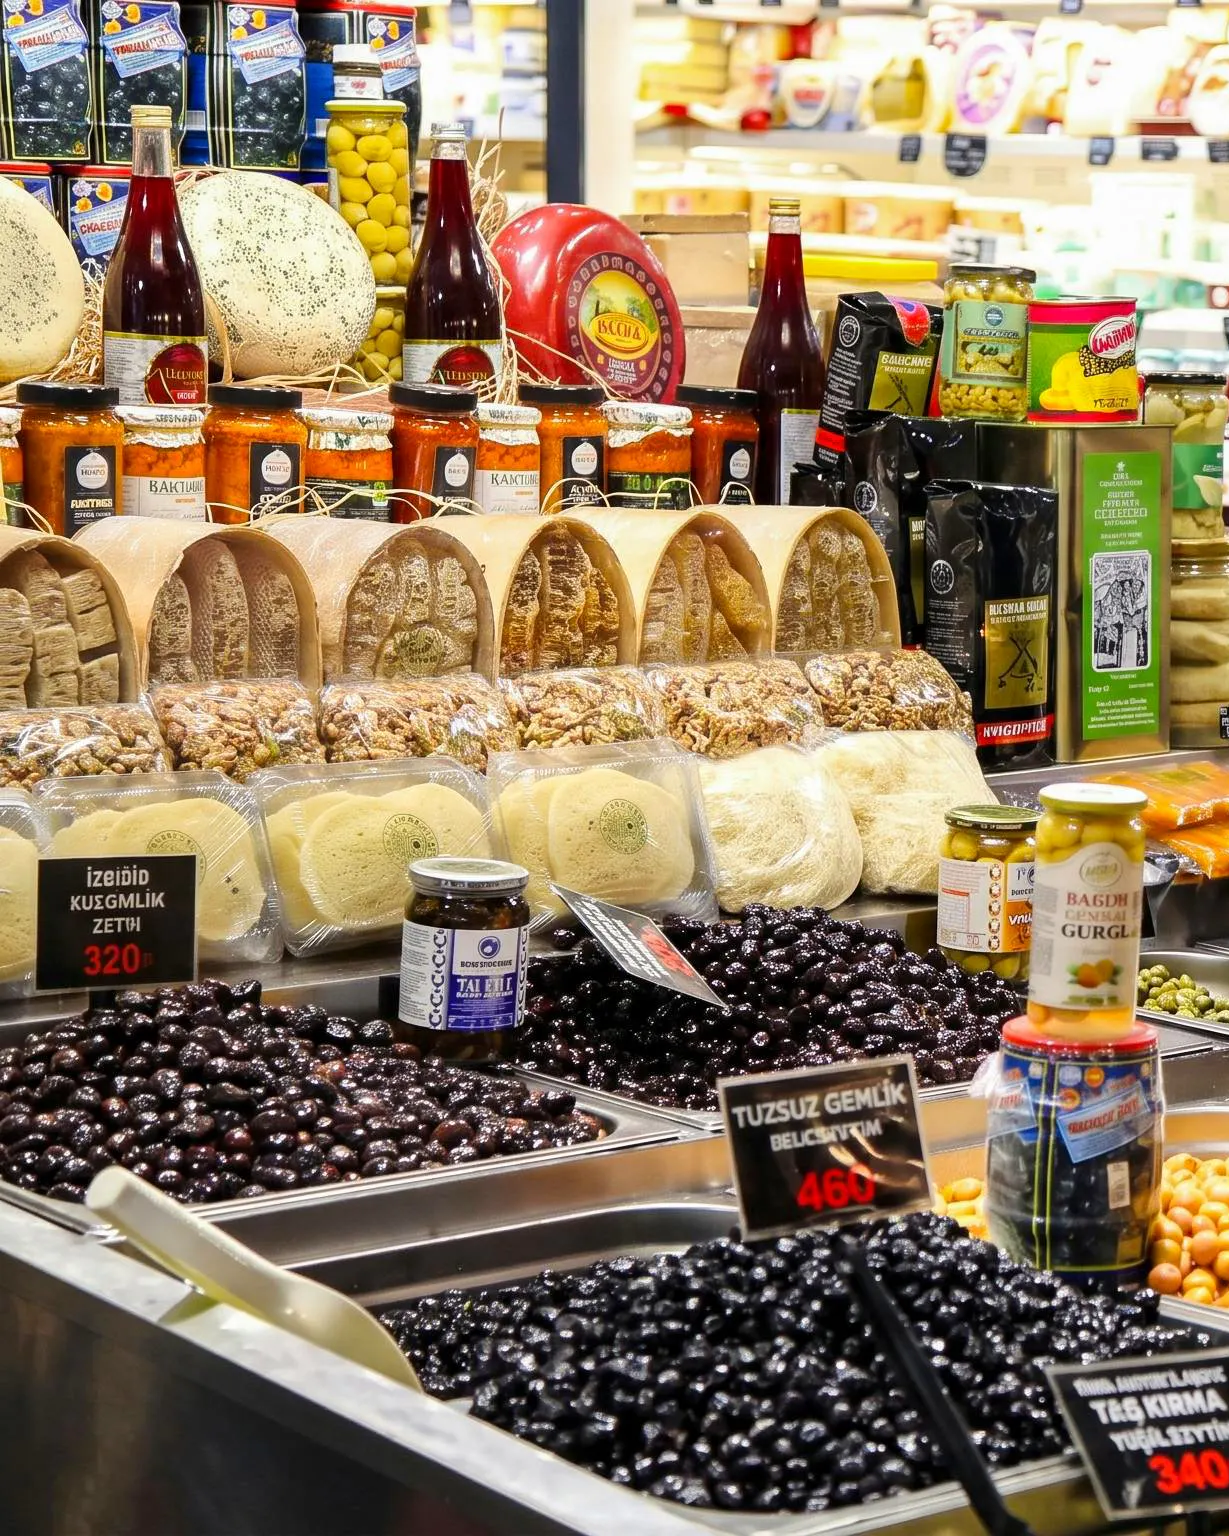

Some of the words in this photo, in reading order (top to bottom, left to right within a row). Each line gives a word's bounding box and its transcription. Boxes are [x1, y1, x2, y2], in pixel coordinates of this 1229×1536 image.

[83, 943, 141, 976] 320
[731, 1095, 821, 1129] TUZSUZ
[823, 1078, 908, 1115] GEMLİK
[795, 1161, 877, 1212] 460
[1143, 1388, 1228, 1419] KIRMA
